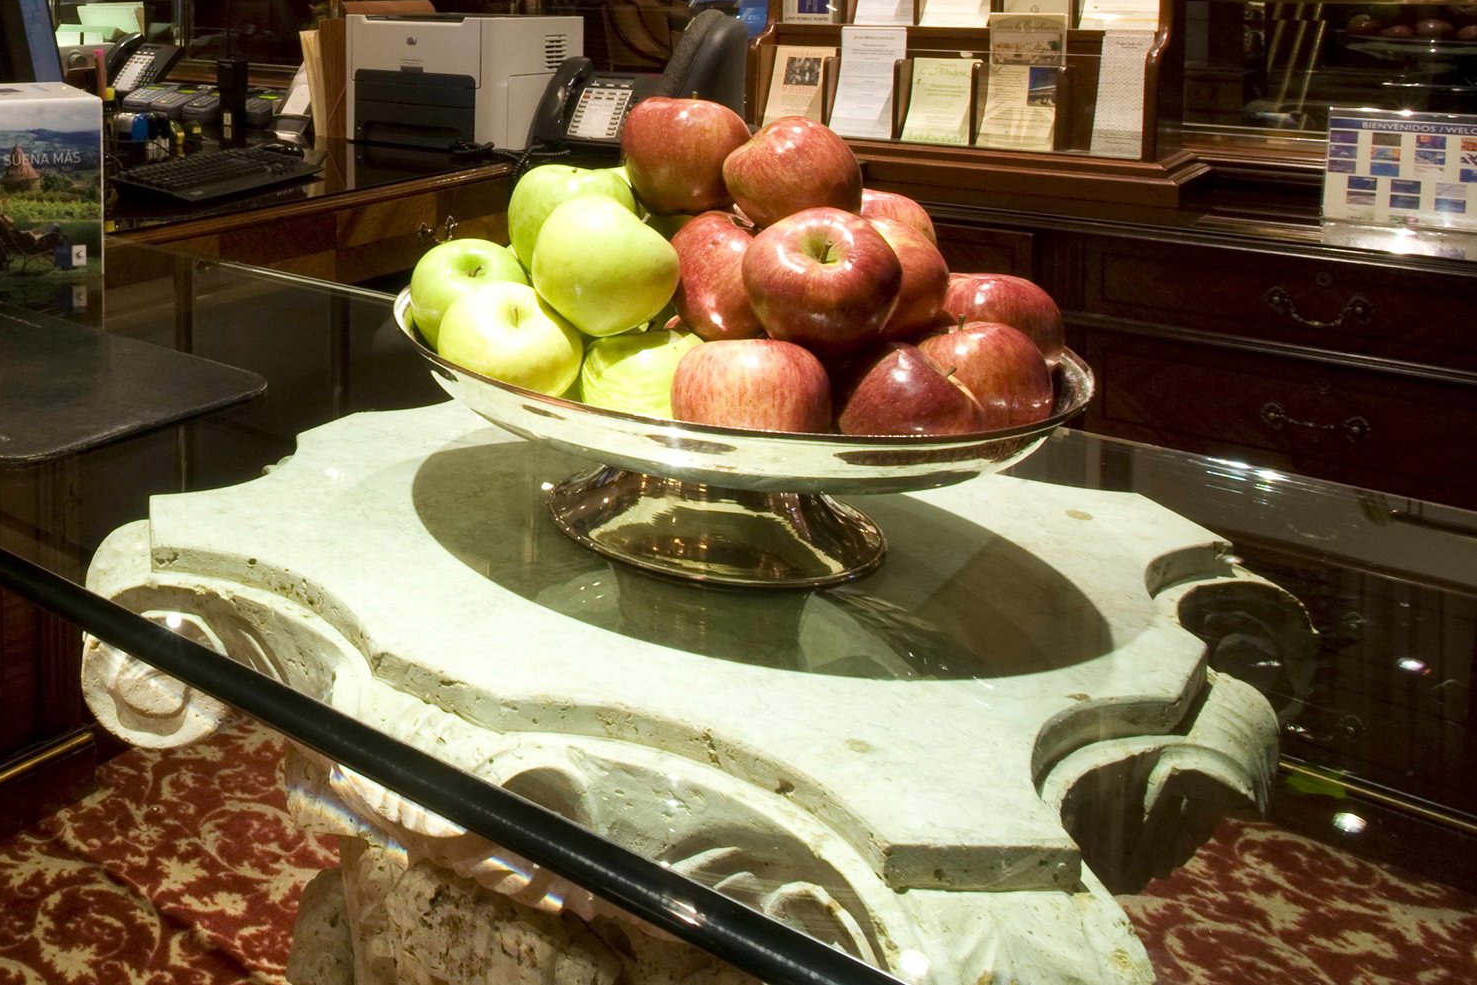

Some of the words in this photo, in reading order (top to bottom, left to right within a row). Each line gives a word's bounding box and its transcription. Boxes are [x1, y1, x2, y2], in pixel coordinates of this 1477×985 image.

[1362, 121, 1437, 133] BIENVENIDOS
[1445, 126, 1477, 135] WELC
[3, 150, 50, 166] SUEÑA
[53, 149, 82, 165] MÁS
